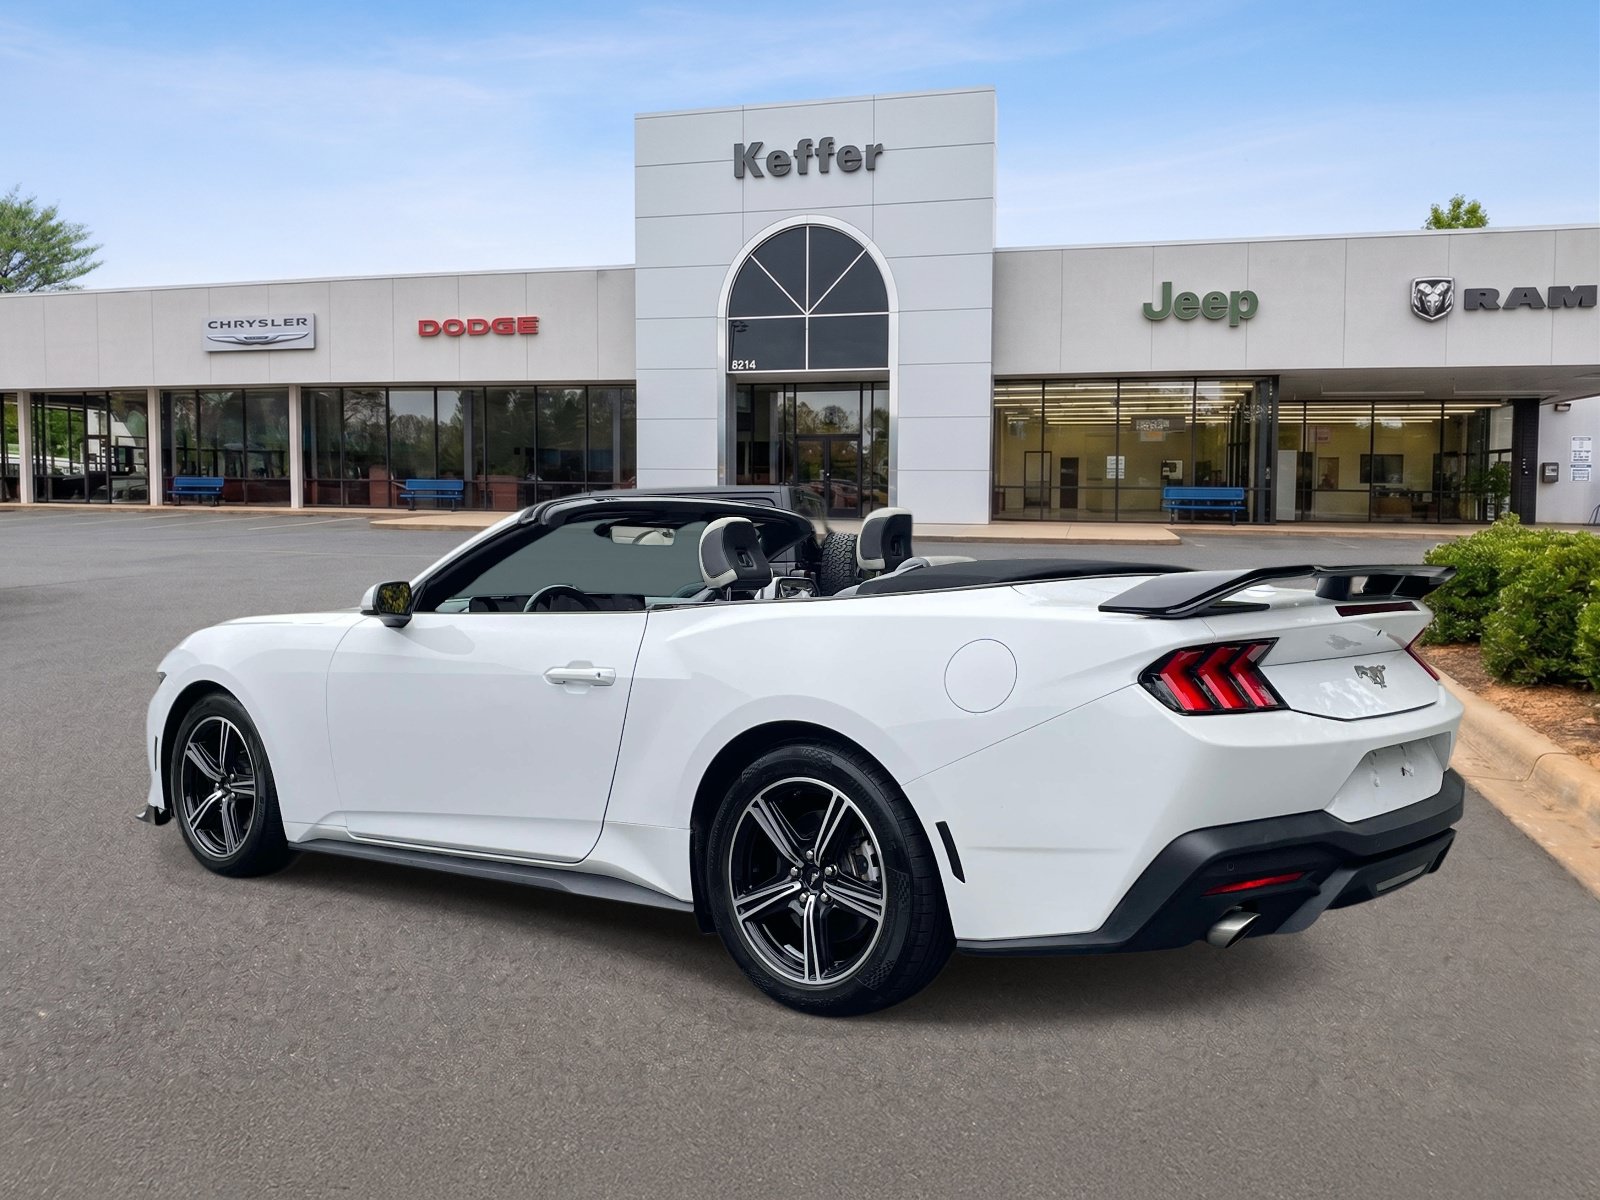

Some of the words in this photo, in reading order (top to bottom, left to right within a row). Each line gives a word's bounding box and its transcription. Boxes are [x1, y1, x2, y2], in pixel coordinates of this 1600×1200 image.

[734, 137, 883, 178] Keffer
[1143, 282, 1259, 327] Jeep
[1464, 285, 1598, 310] RAM
[208, 318, 308, 329] CHRYSLER
[418, 317, 539, 337] DODGE
[731, 360, 756, 369] 8214
